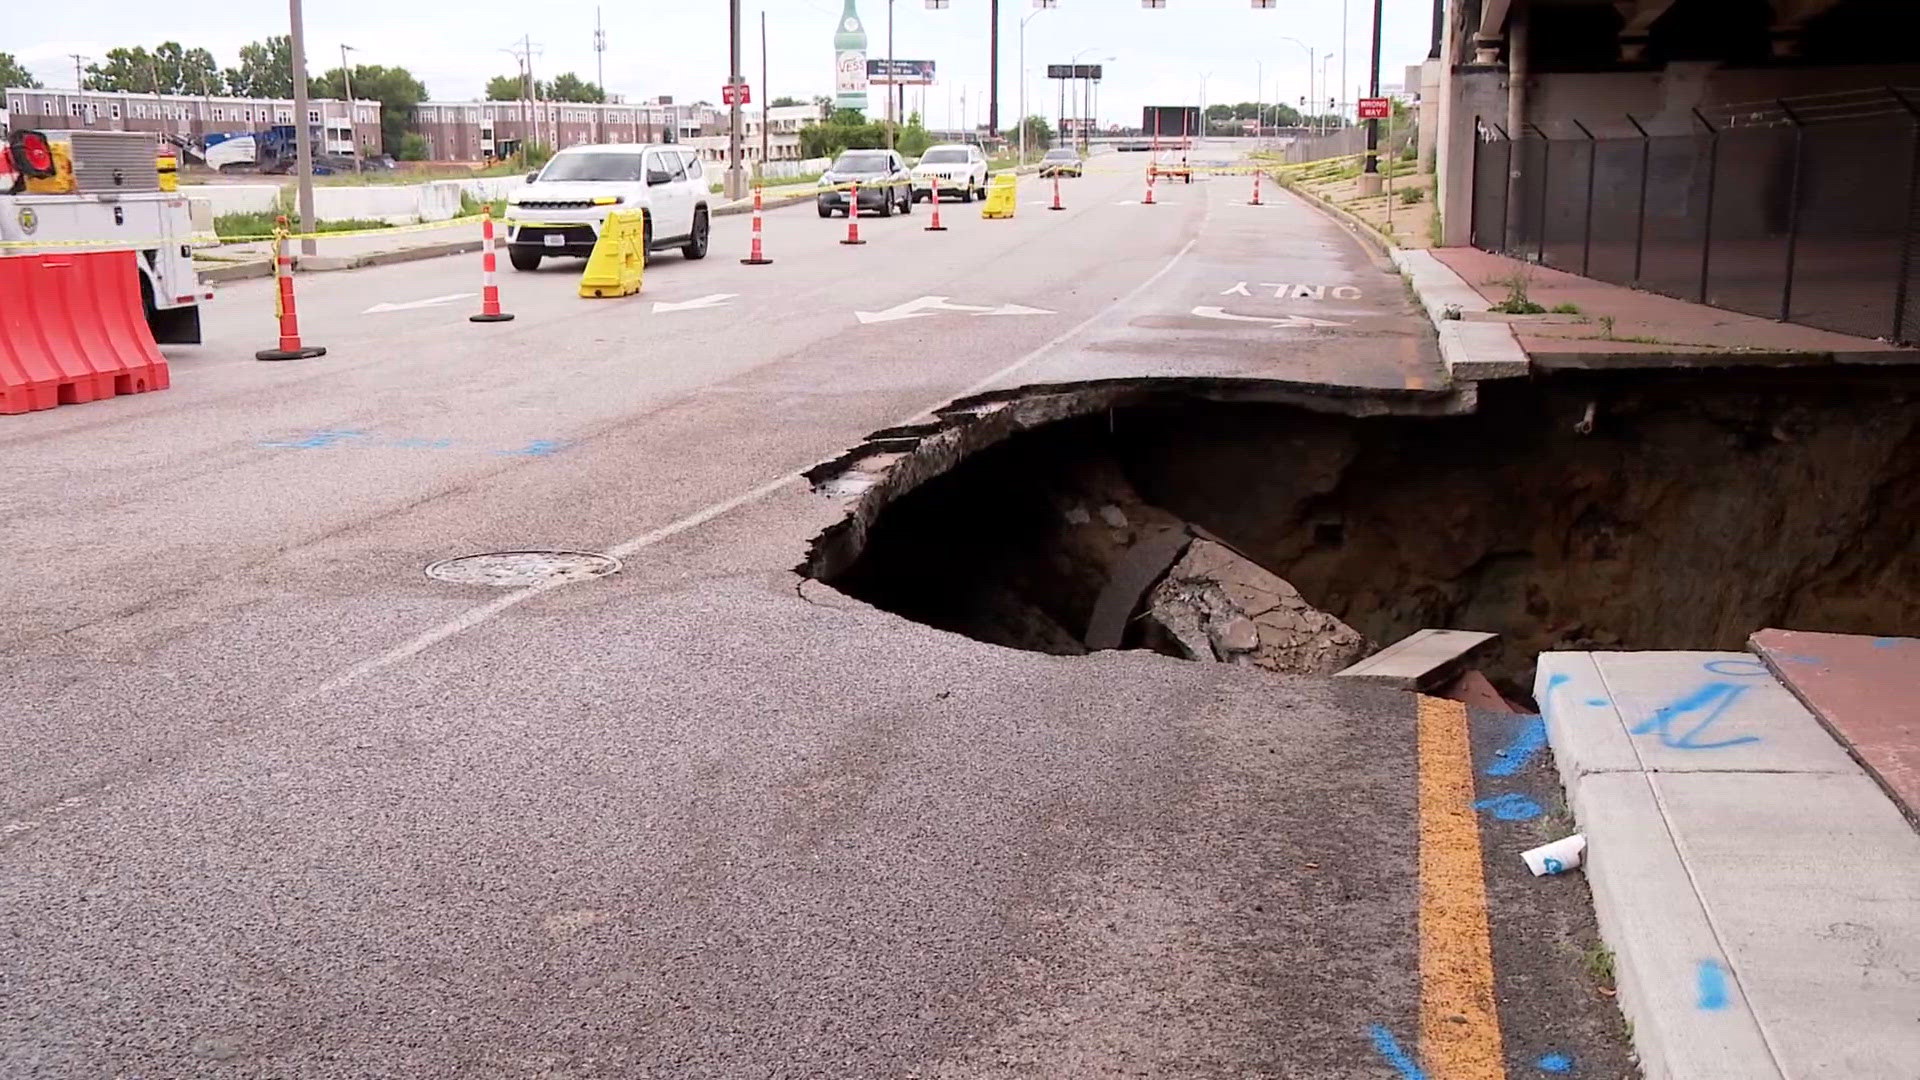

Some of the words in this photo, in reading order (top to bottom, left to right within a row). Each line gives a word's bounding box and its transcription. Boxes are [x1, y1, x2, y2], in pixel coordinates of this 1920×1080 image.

[838, 58, 865, 73] VESS
[1360, 100, 1387, 108] WRONG
[1219, 281, 1363, 300] ONLY
